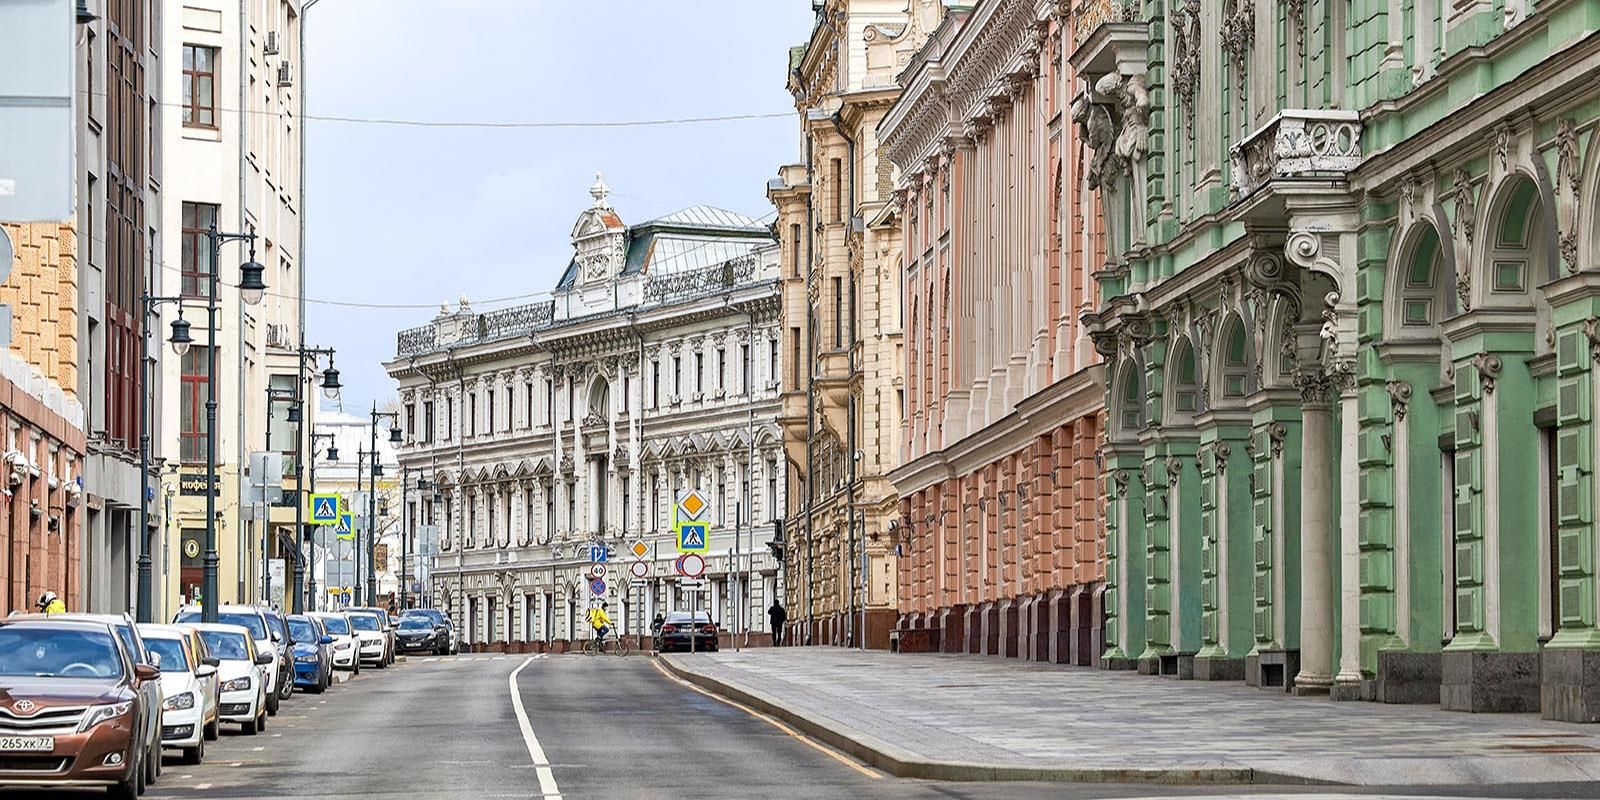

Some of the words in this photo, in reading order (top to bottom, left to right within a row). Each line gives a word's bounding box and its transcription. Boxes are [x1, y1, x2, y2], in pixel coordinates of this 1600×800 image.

[182, 479, 221, 491] кофея
[0, 738, 36, 749] 265ХК
[40, 737, 50, 746] 77
